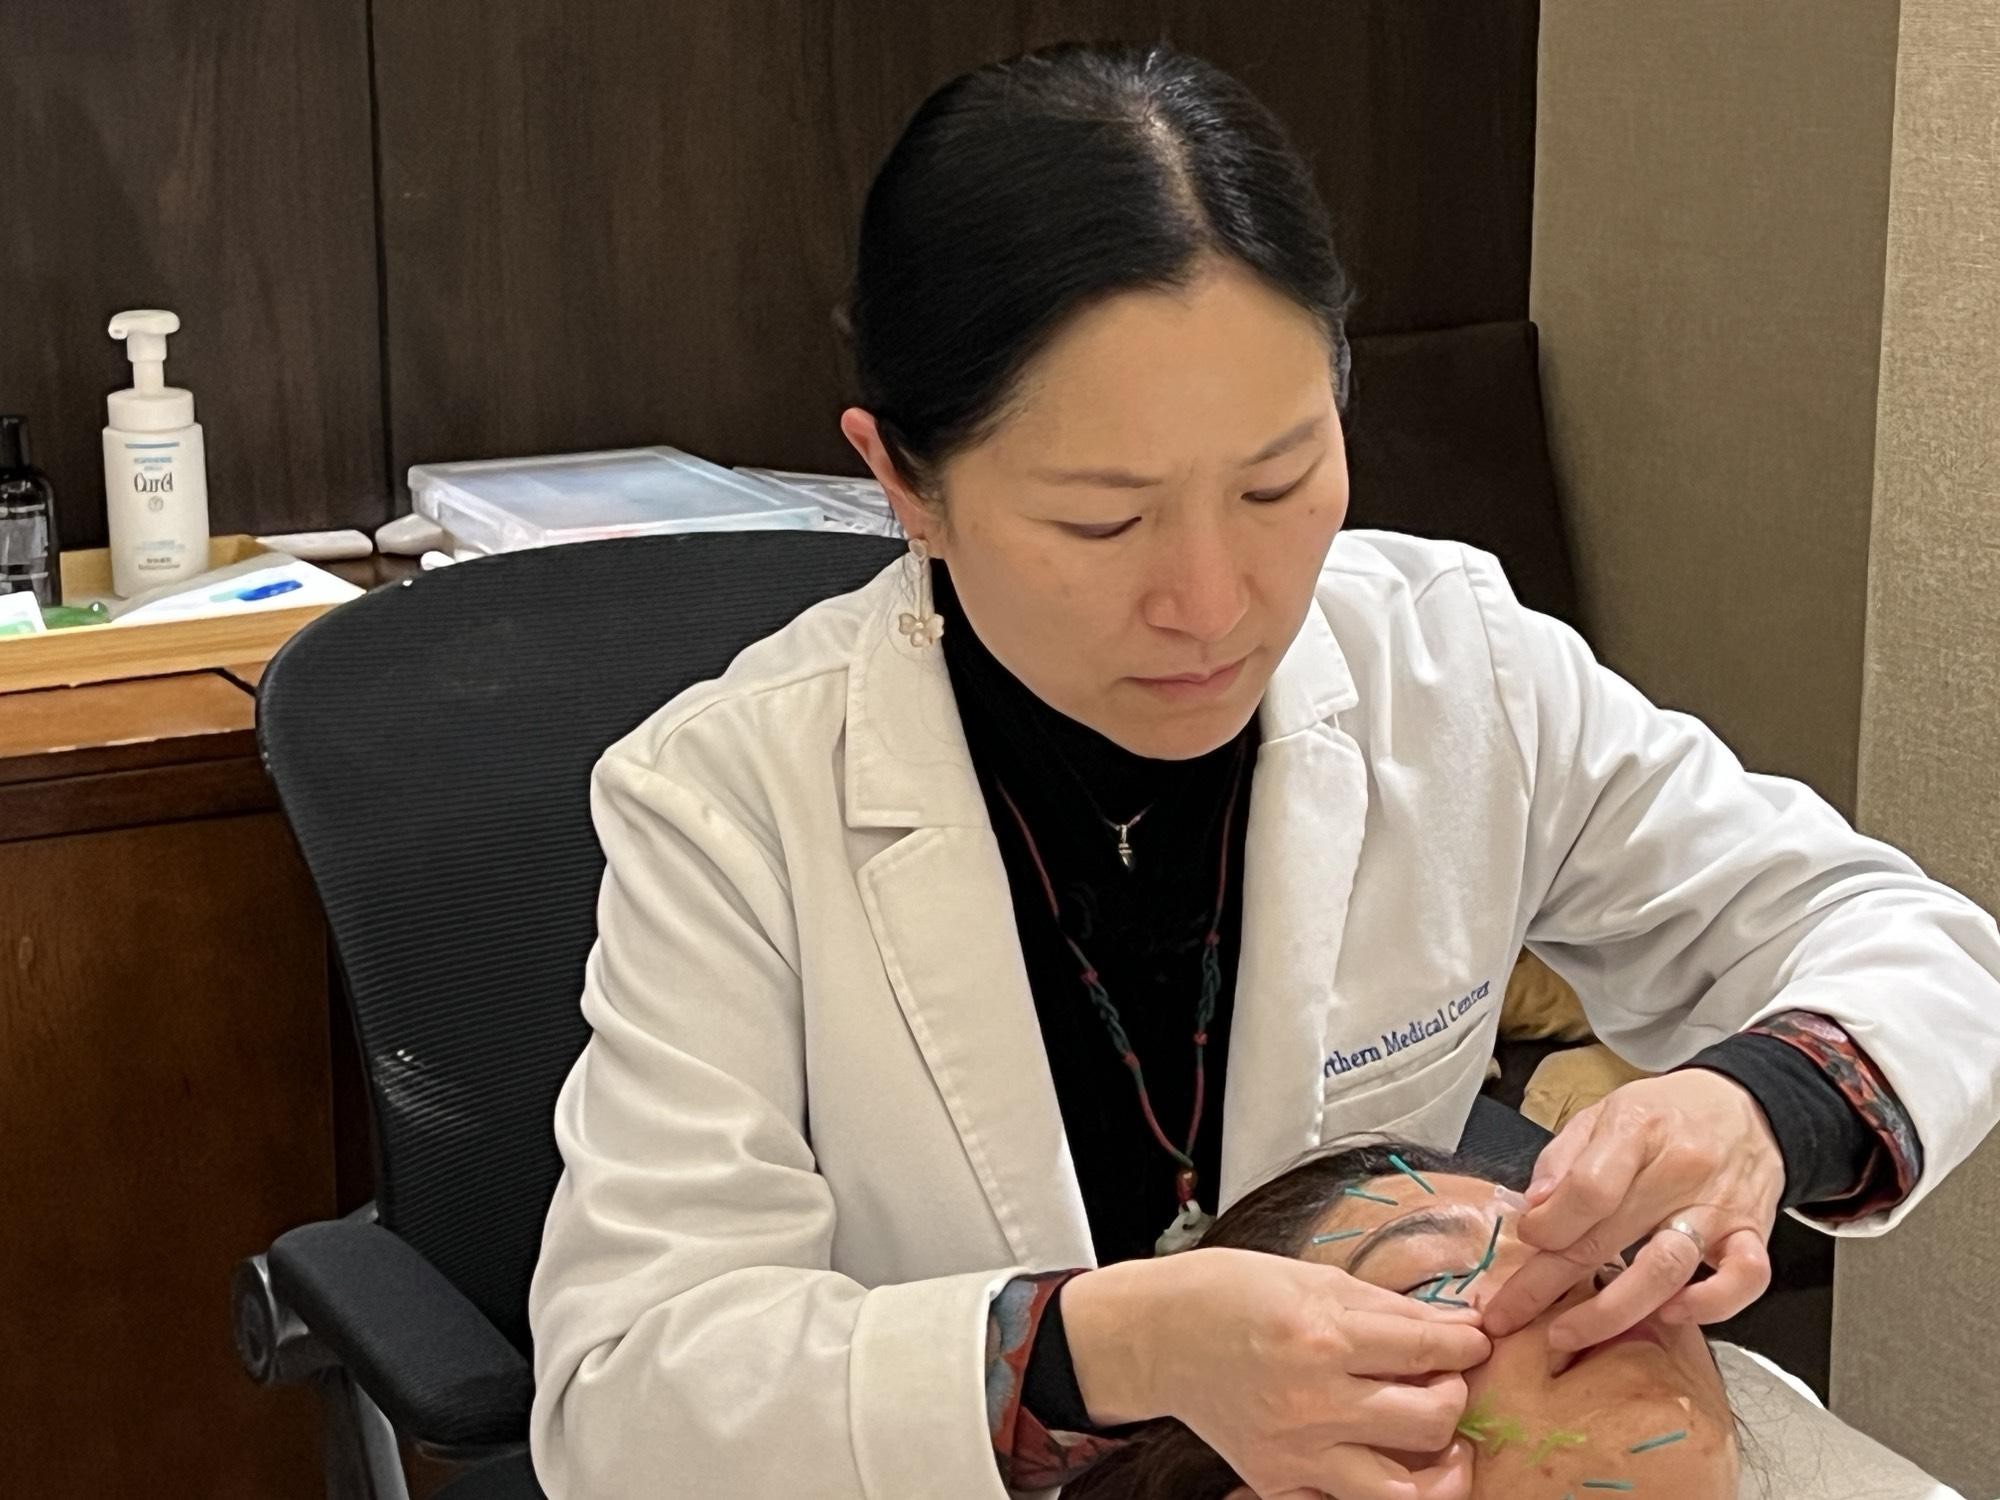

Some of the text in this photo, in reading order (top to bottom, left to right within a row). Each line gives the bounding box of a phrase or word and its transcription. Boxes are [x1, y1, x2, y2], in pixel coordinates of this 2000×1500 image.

[1324, 980, 1490, 1078] rthern Medical Center
